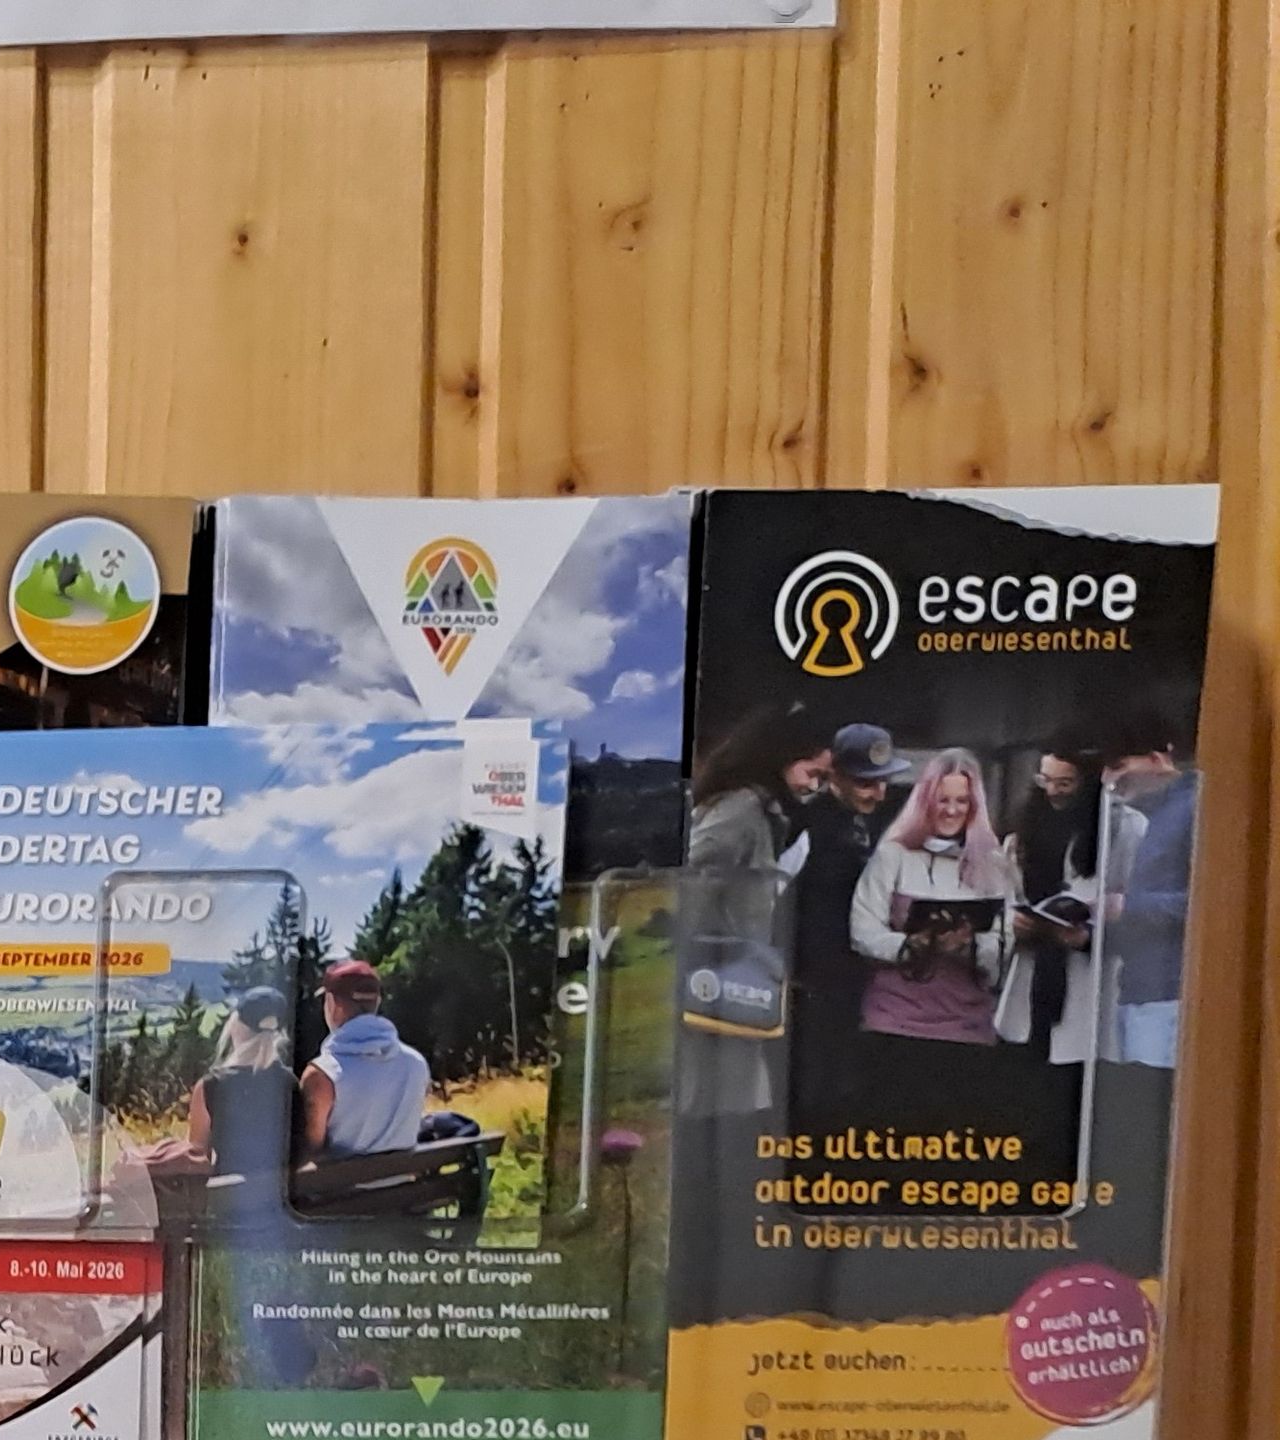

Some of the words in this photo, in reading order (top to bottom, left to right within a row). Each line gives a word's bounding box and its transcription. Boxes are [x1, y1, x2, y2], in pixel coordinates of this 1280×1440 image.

[918, 573, 1138, 623] escape
[402, 614, 500, 627] EURORANDO
[756, 1134, 813, 1160] Das
[825, 1127, 1024, 1161] ultimative
[754, 1171, 890, 1207] outdoor
[900, 1179, 1020, 1212] escape
[754, 1215, 793, 1249] in
[56, 1260, 84, 1279] Mai
[87, 1261, 125, 1280] 2026
[301, 1248, 361, 1268] Hiking
[365, 1249, 383, 1264] in
[388, 1249, 419, 1265] the
[424, 1249, 460, 1265] Ore
[465, 1248, 562, 1265] Mountains
[328, 1269, 345, 1285] in
[352, 1269, 383, 1285] the
[386, 1269, 439, 1285] heart
[443, 1268, 462, 1285] of
[467, 1269, 533, 1288] Europe
[252, 1303, 354, 1320] Randonnée
[359, 1303, 402, 1320] dans
[406, 1303, 433, 1320] les
[438, 1303, 495, 1320] Monts
[499, 1302, 610, 1321] Métallifères
[1040, 1310, 1083, 1332] auch
[1087, 1306, 1122, 1326] als
[337, 1325, 360, 1339] au
[416, 1323, 440, 1339] de
[746, 1351, 815, 1376] jetzt
[266, 1416, 591, 1440] www.eurorando2026.eu
